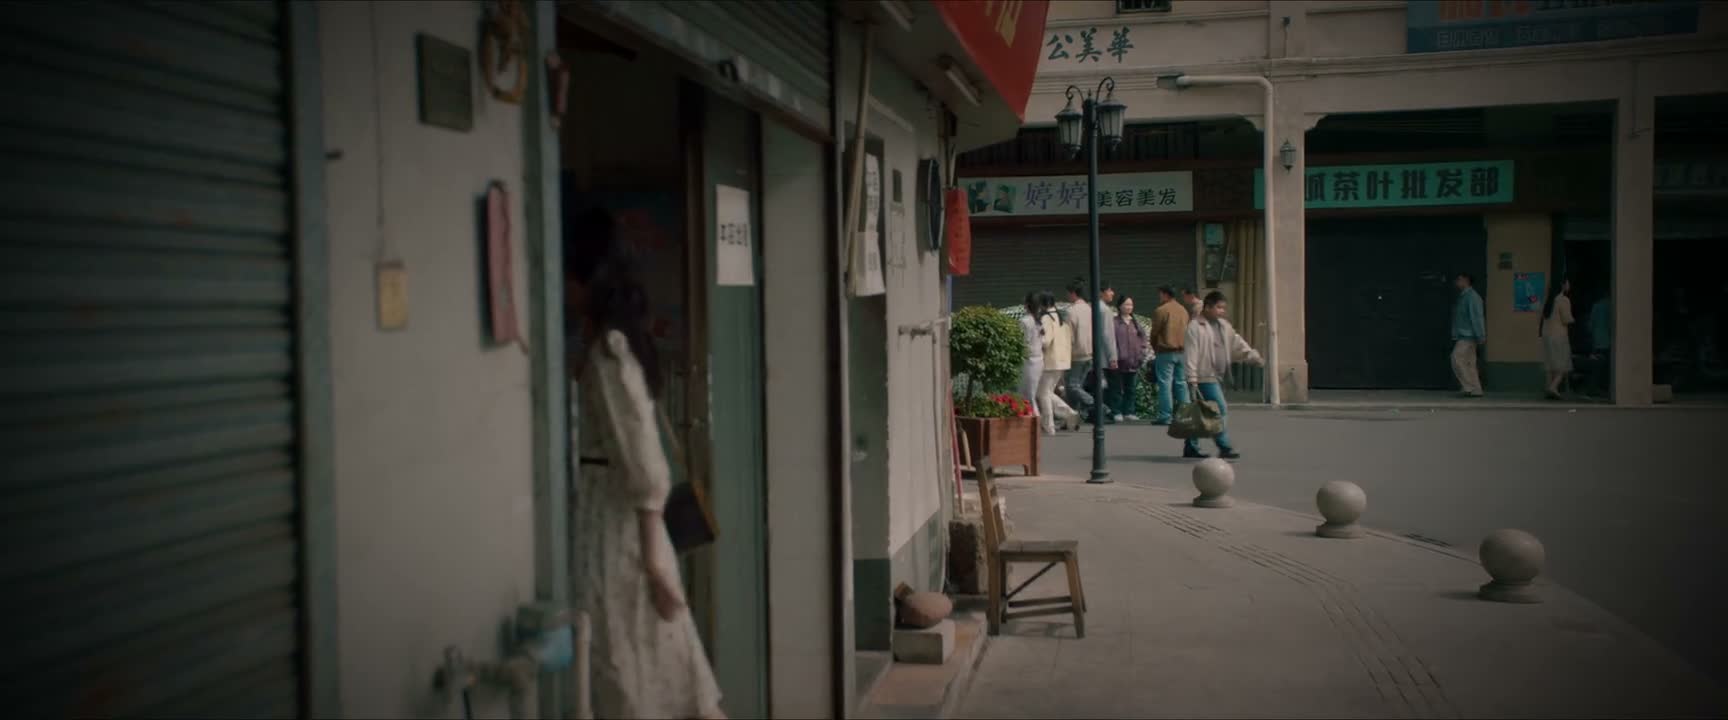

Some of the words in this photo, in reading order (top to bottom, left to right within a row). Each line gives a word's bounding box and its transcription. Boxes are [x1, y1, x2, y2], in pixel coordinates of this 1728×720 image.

[1024, 181, 1088, 210] 婷婷
[1097, 188, 1177, 209] 美容美发
